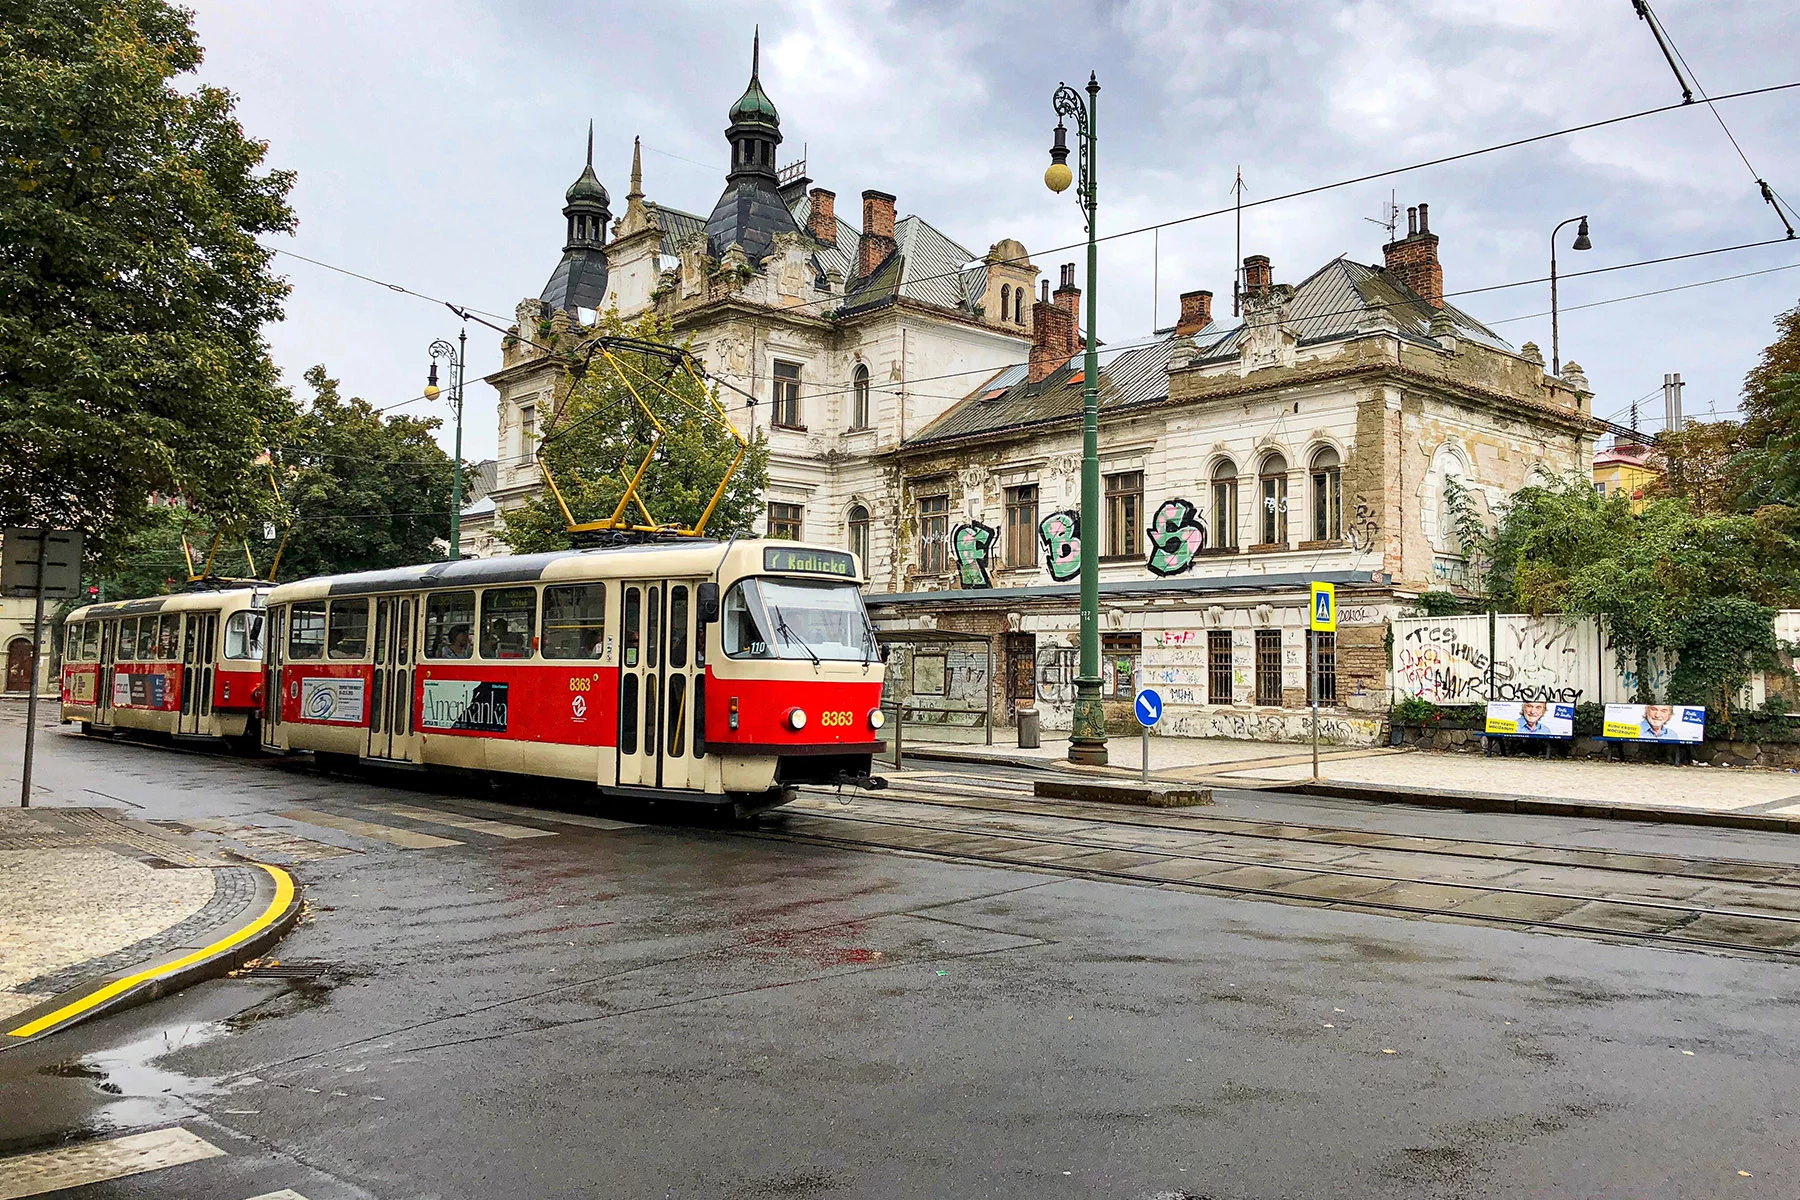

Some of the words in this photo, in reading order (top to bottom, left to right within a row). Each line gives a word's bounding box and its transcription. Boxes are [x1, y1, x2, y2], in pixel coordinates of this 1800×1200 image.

[751, 642, 765, 653] 110
[569, 677, 591, 691] 8363
[423, 688, 508, 726] Amerikánka
[821, 711, 853, 726] 8363
